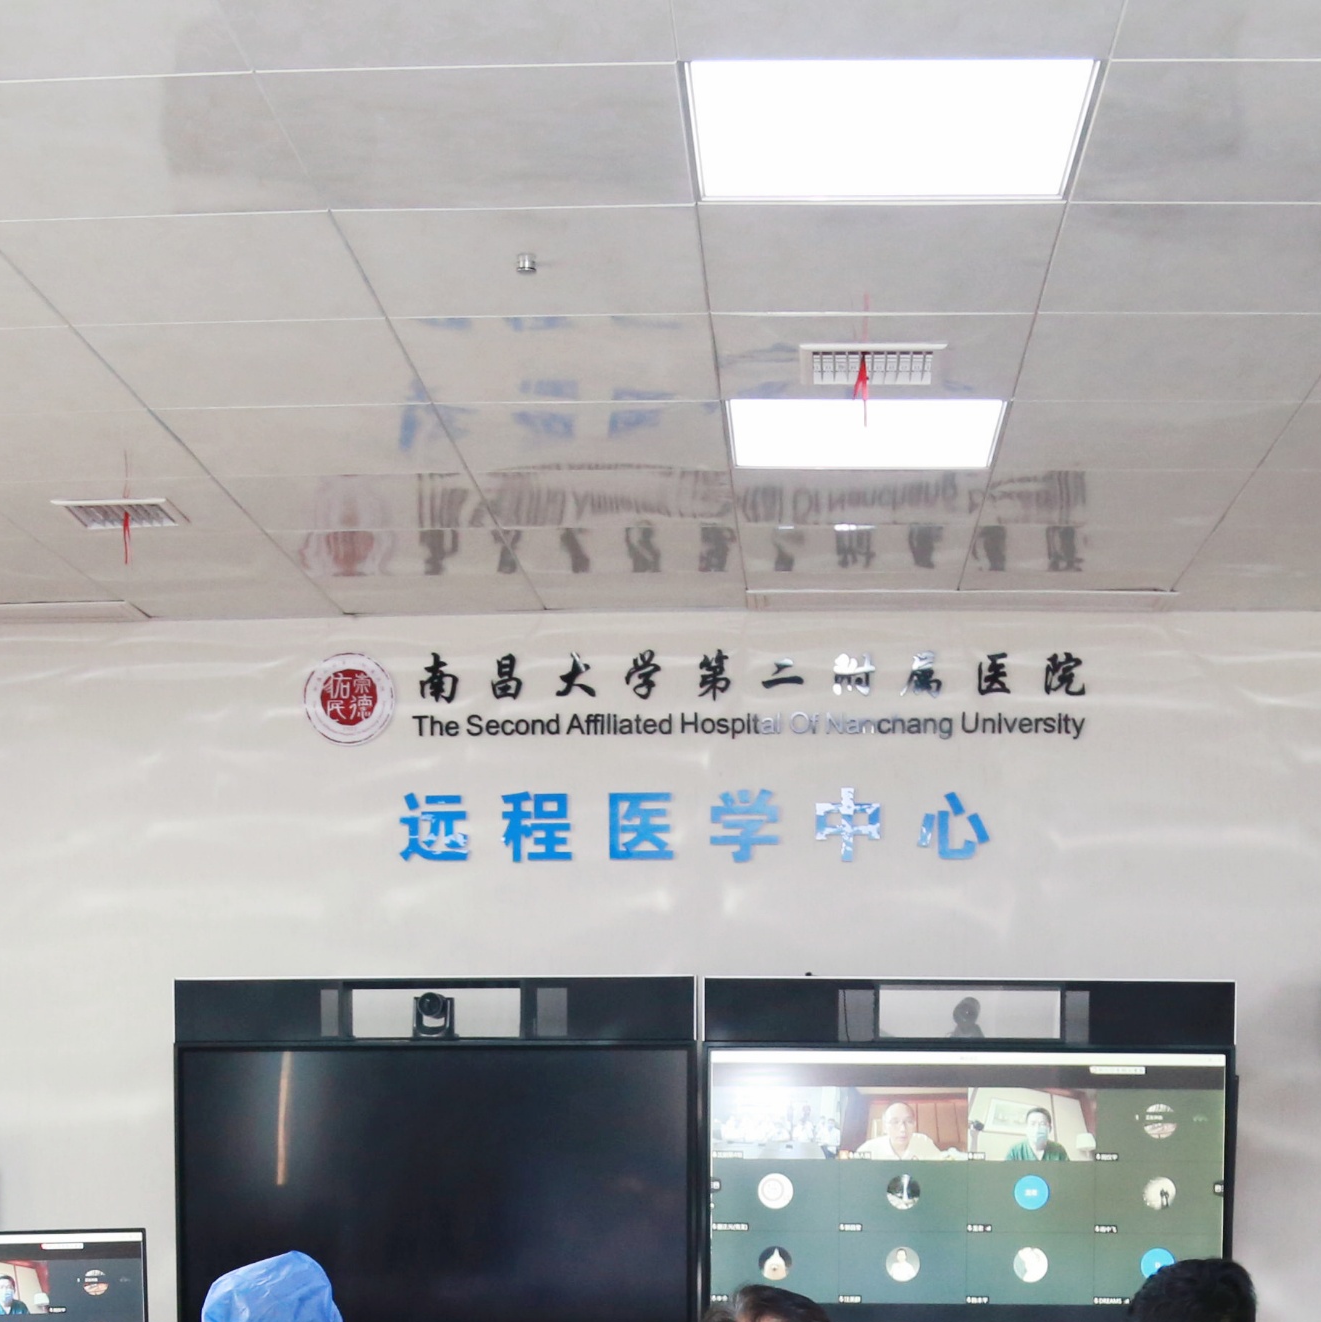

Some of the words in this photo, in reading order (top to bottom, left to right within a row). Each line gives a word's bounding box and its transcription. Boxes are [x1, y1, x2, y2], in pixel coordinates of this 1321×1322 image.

[420, 649, 1086, 704] 南昌大学第二附属医院
[412, 714, 460, 736] The
[466, 714, 560, 736] Second
[566, 713, 673, 735] Affiliated
[680, 712, 780, 739] Hospital
[789, 711, 819, 735] Of
[826, 712, 953, 740] Nanchang
[960, 711, 1086, 740] University
[400, 787, 990, 862] 远程医学中心
